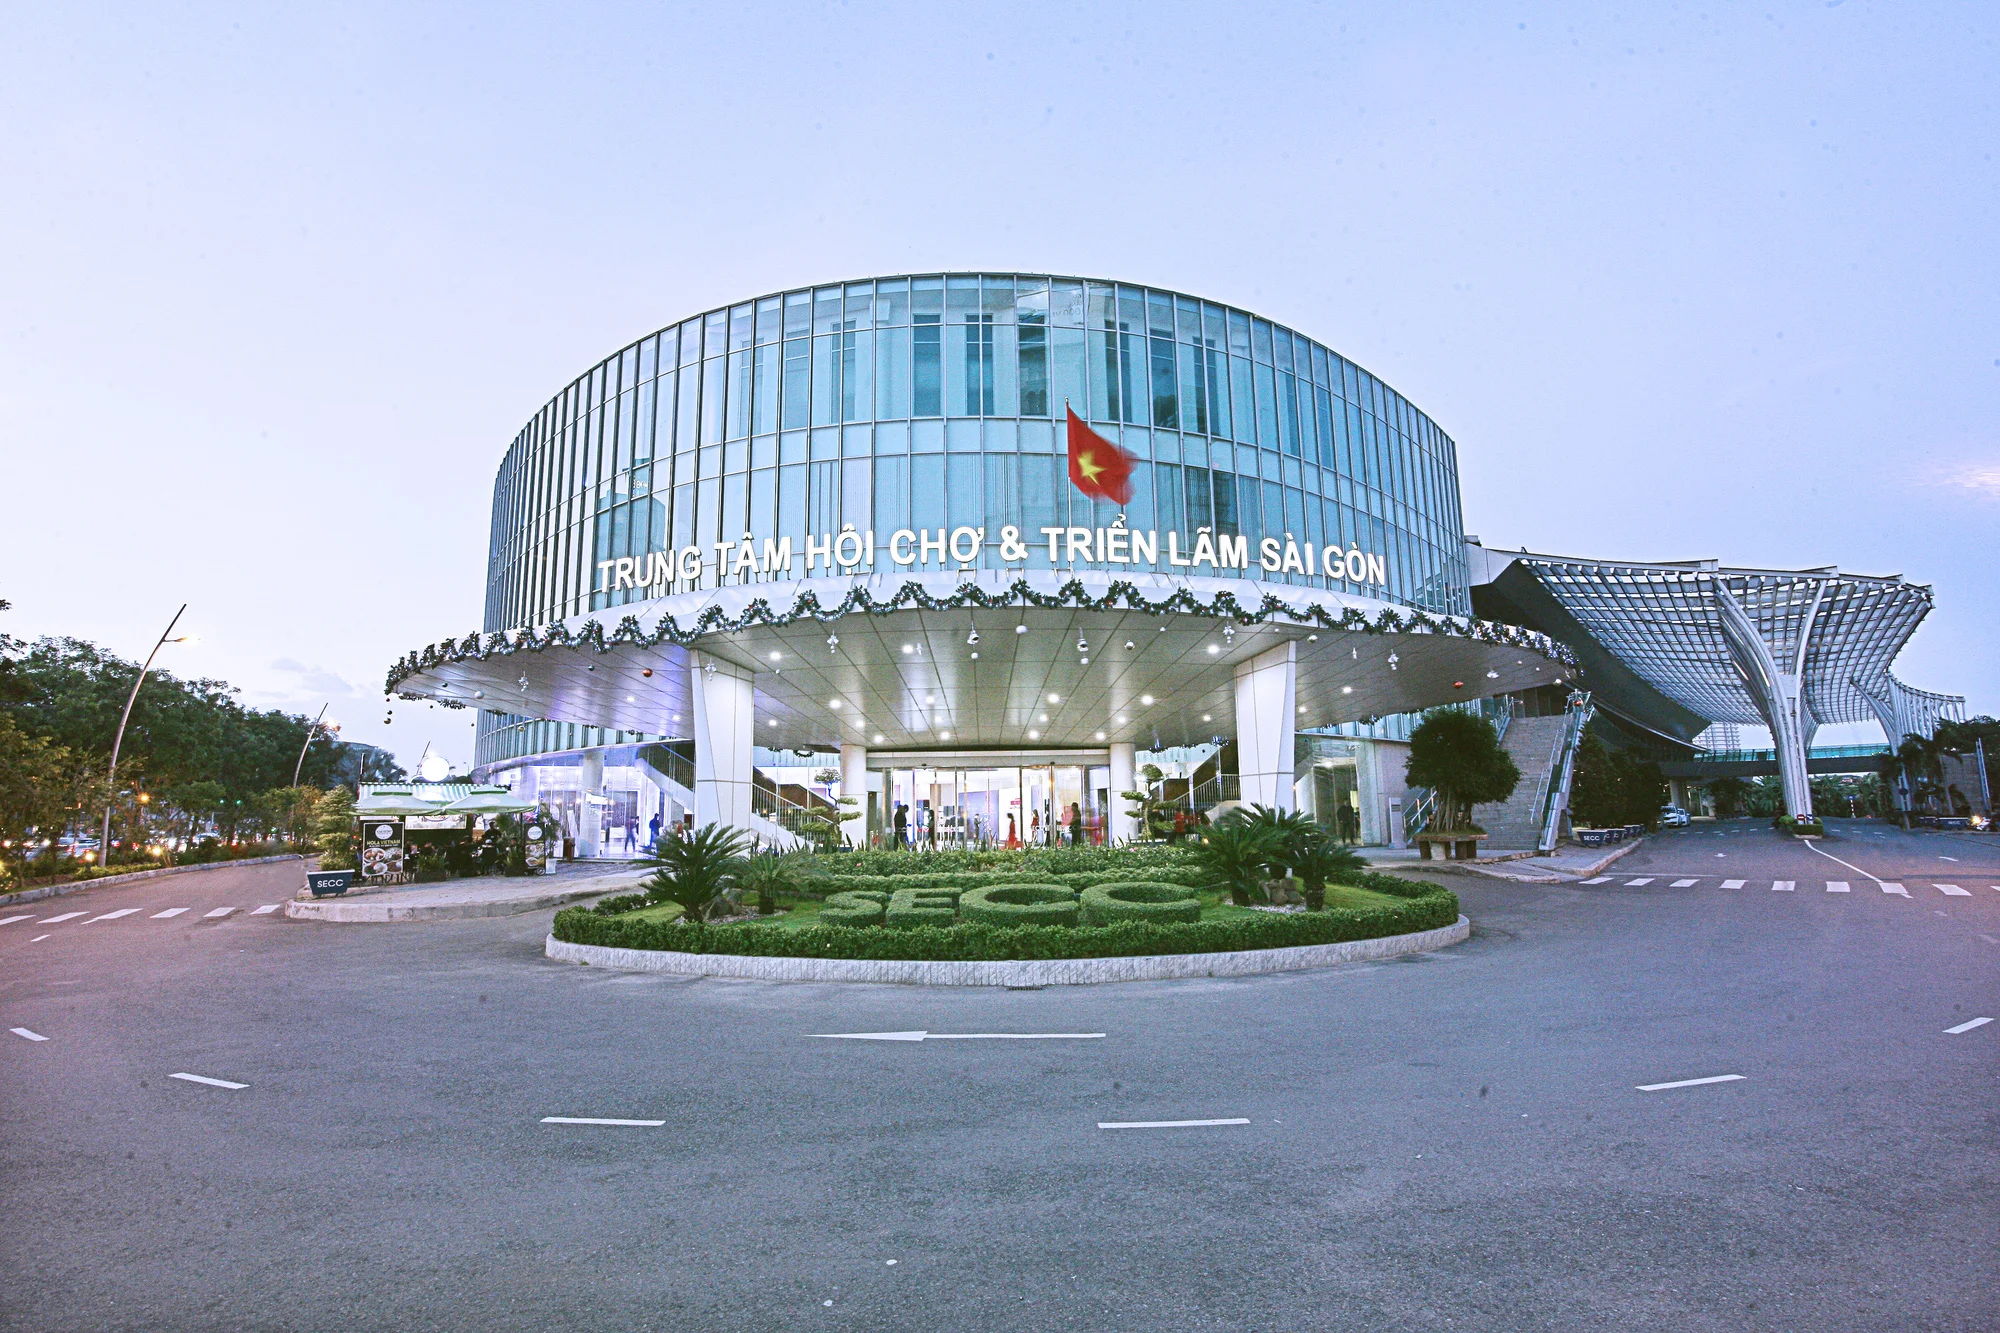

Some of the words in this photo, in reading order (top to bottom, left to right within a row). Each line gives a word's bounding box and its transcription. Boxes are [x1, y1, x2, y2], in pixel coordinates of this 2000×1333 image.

[598, 545, 702, 593] TRUNG
[714, 532, 792, 577] TÂM
[806, 523, 875, 575] HỘI
[890, 526, 985, 571] CHỢ
[999, 525, 1029, 562] &
[1041, 513, 1157, 564] TRIỂN
[1169, 527, 1248, 569] LÃM
[1261, 532, 1314, 576] SÀI
[1322, 542, 1385, 586] GÒN
[317, 879, 344, 888] SECC
[820, 881, 1200, 927] SECC
